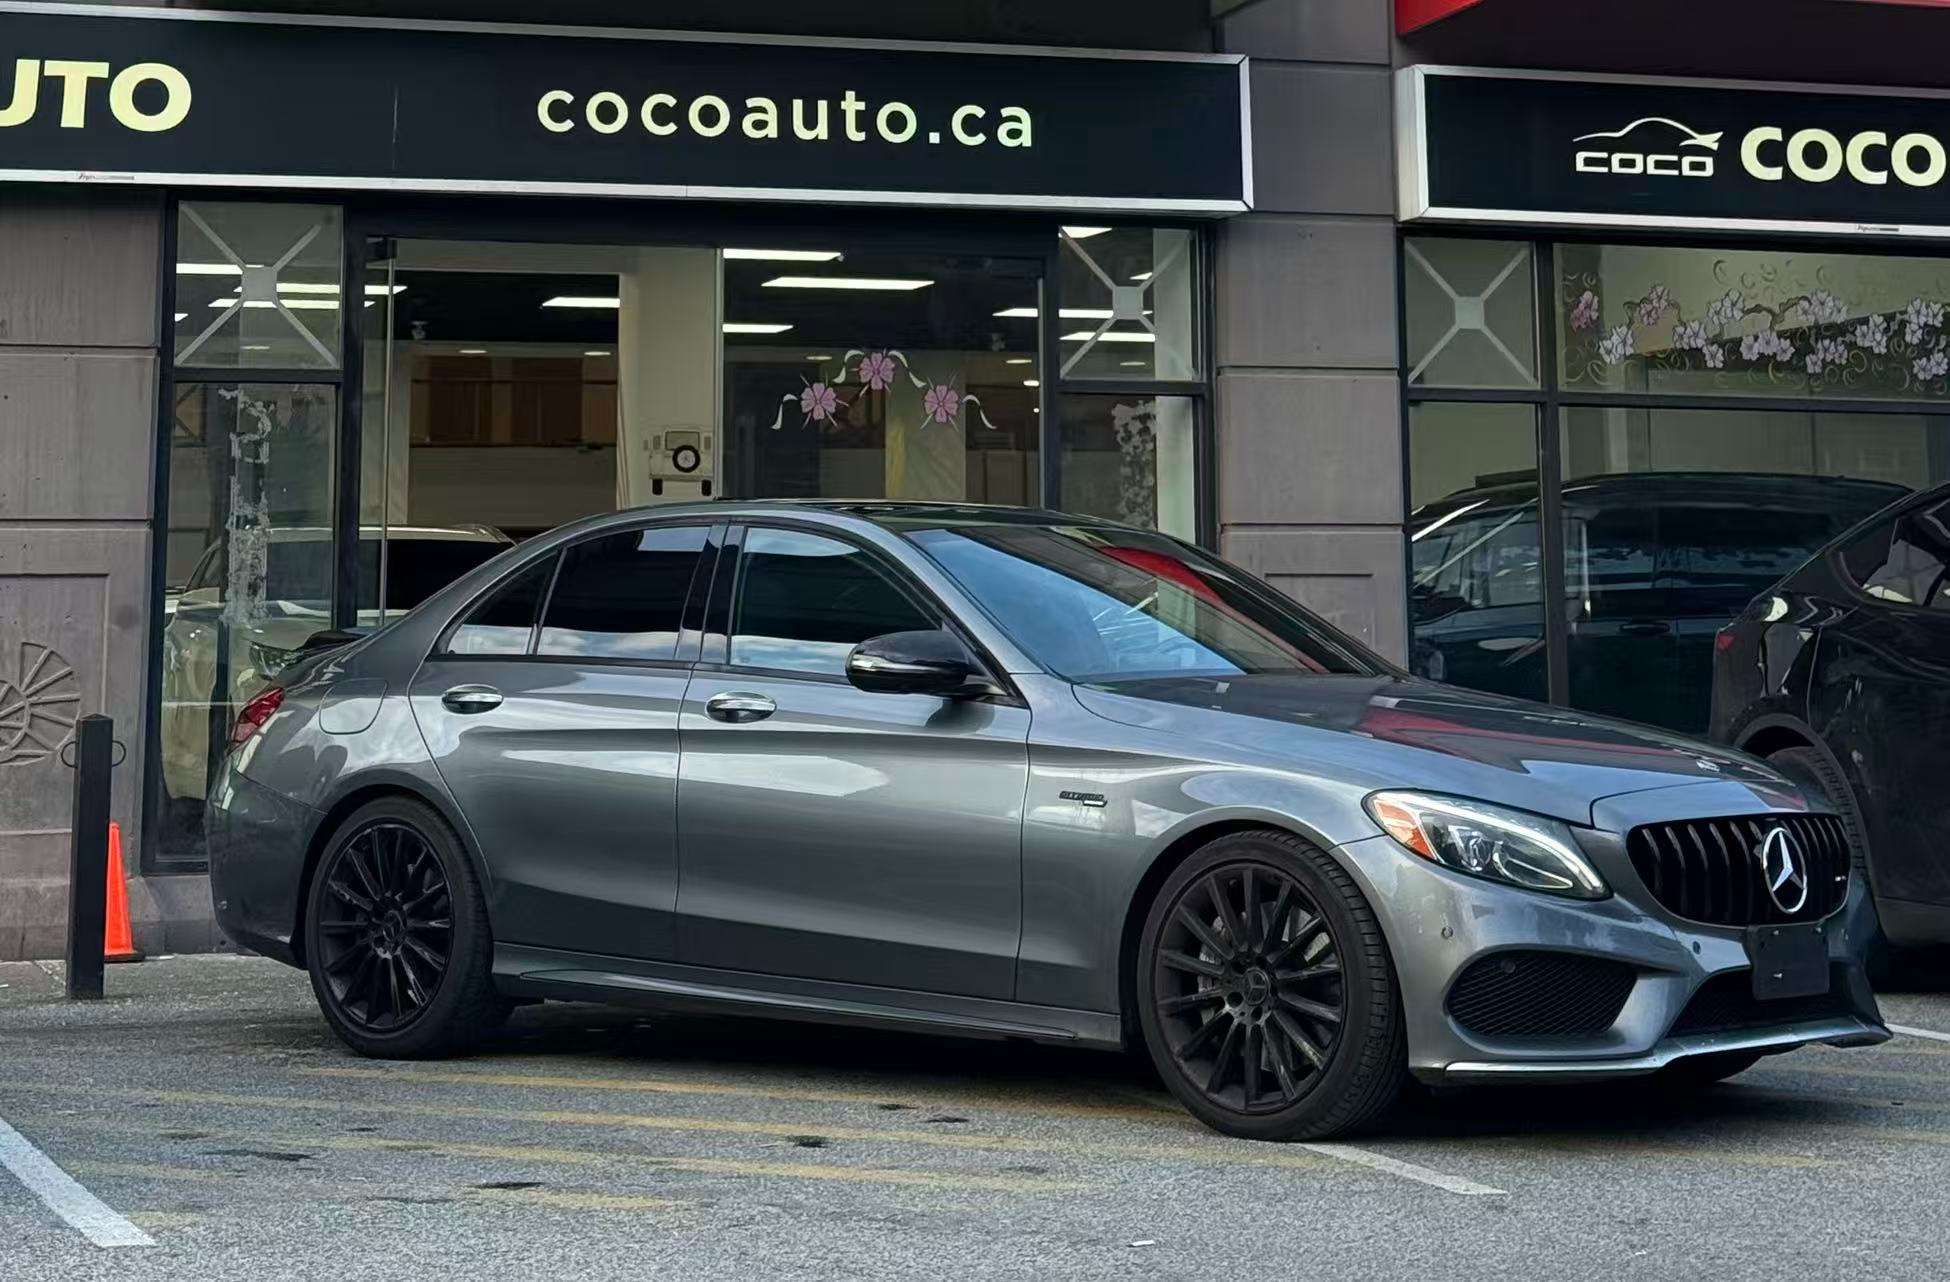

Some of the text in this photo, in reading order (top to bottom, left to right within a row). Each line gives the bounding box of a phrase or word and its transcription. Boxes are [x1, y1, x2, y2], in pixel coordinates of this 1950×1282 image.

[537, 89, 1033, 148] cocoauto.ca
[1575, 151, 1714, 177] COCO
[1740, 126, 1947, 187] COCO
